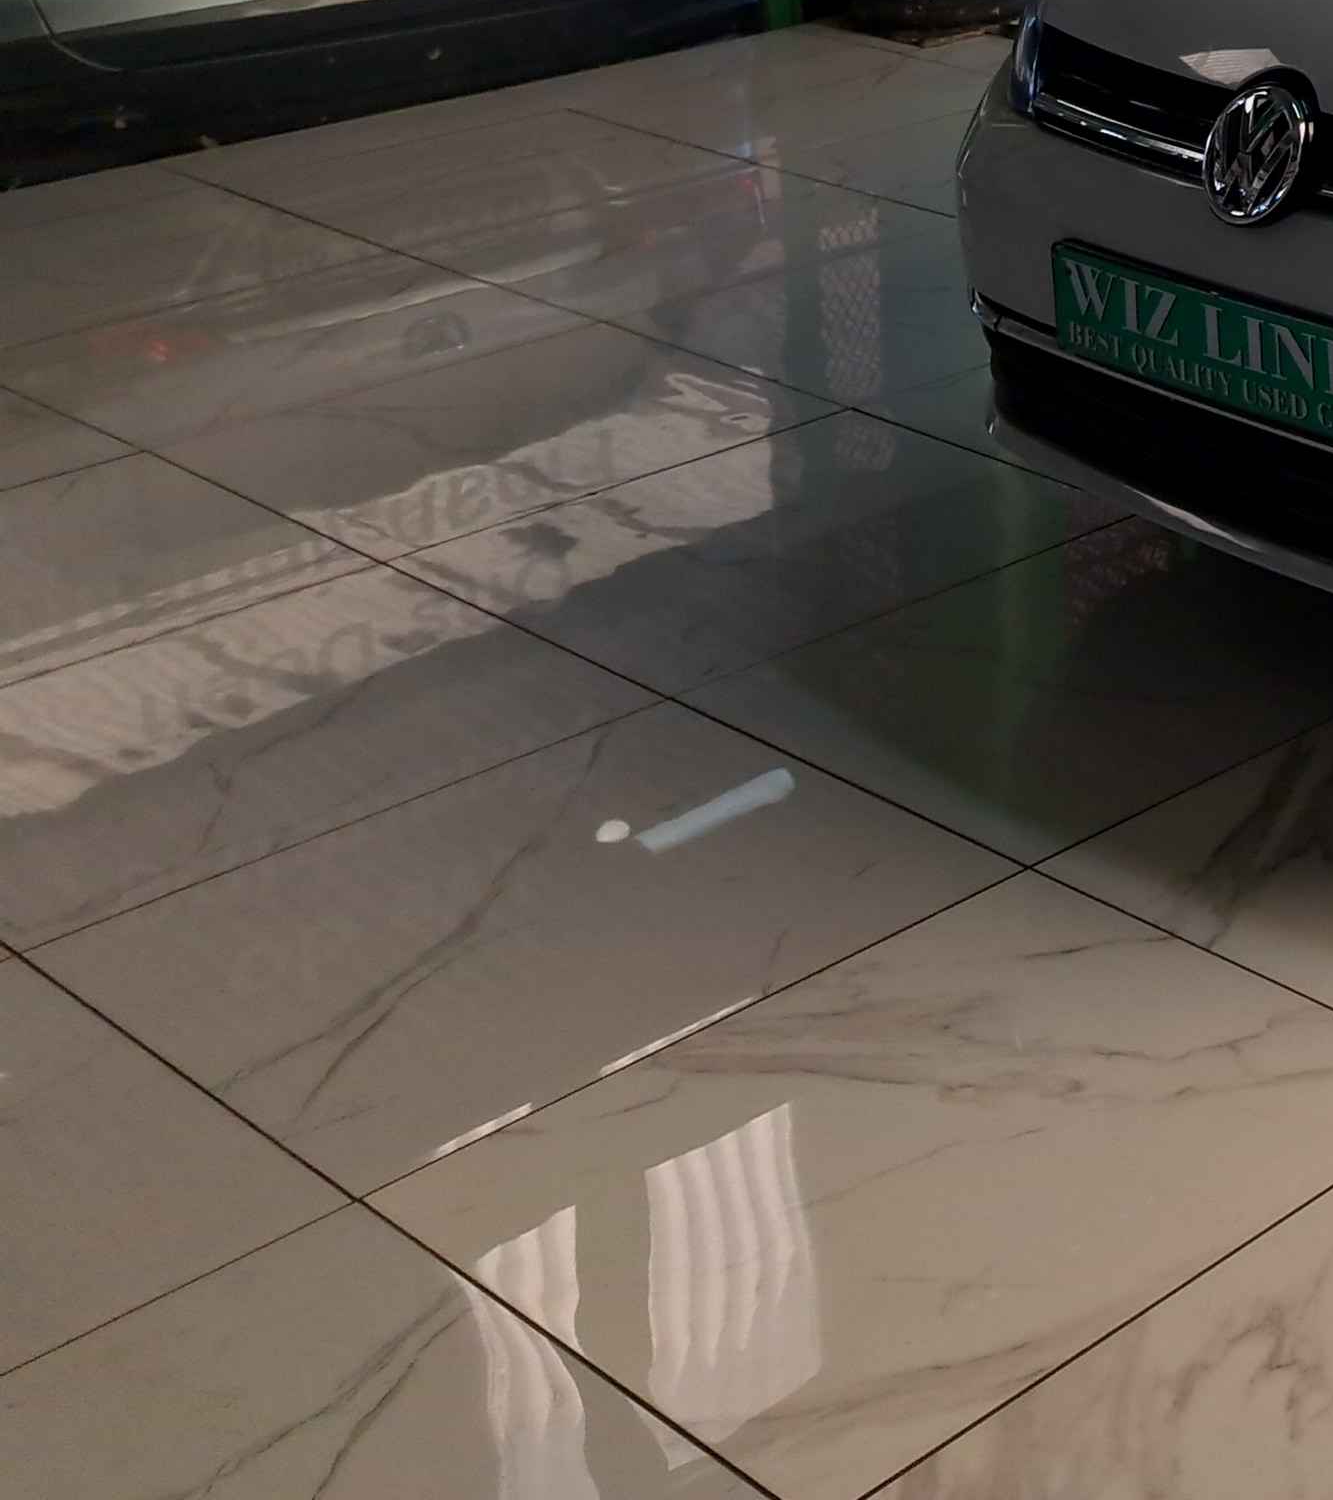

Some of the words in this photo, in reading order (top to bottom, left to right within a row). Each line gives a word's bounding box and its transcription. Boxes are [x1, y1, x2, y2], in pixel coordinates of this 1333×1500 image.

[1064, 258, 1180, 347] WIZ
[1068, 321, 1122, 361] BEST
[1131, 340, 1234, 397] QUALITY
[1243, 377, 1309, 421] USED
